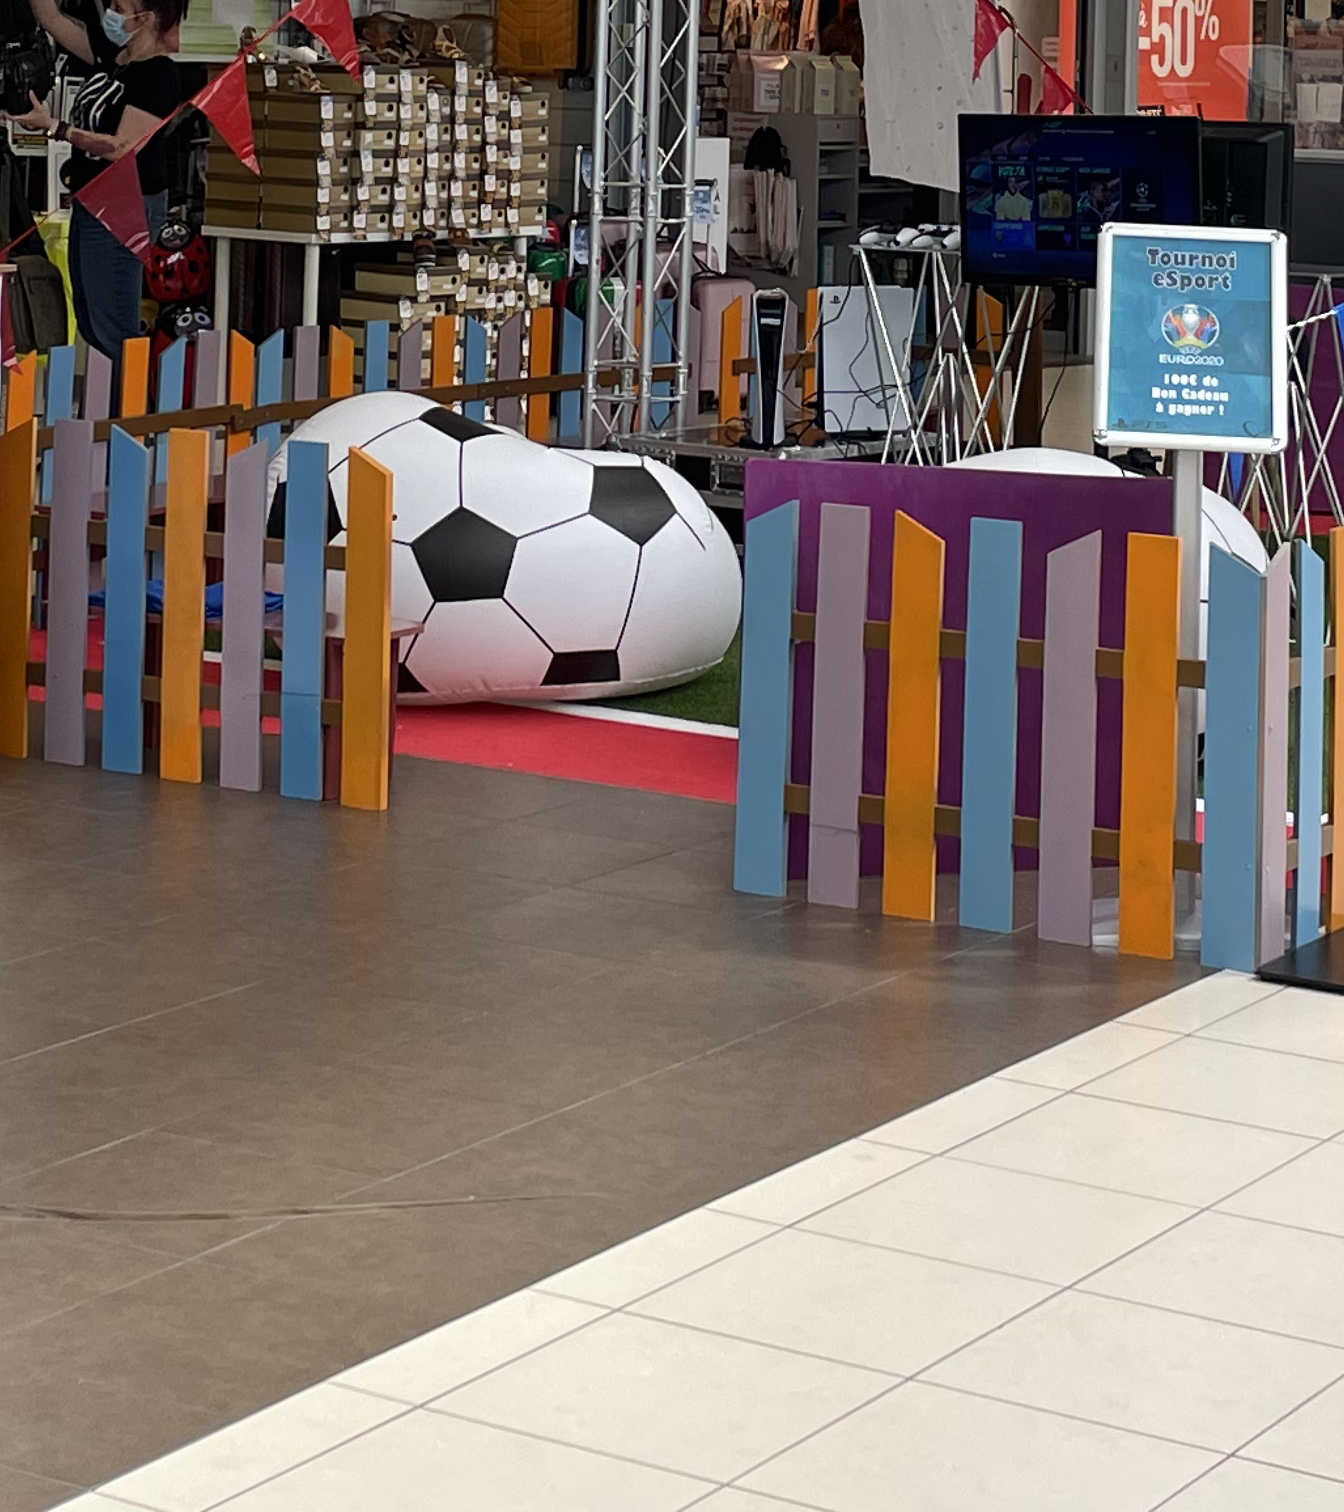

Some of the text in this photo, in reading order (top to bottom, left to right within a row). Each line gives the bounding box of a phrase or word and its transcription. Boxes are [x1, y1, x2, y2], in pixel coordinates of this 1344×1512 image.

[1147, 246, 1237, 270] Tournoi
[1152, 270, 1232, 292] eSport
[1164, 373, 1219, 387] 100€ de
[1151, 387, 1229, 403] Bon Cadeau
[1168, 404, 1215, 417] gagner
